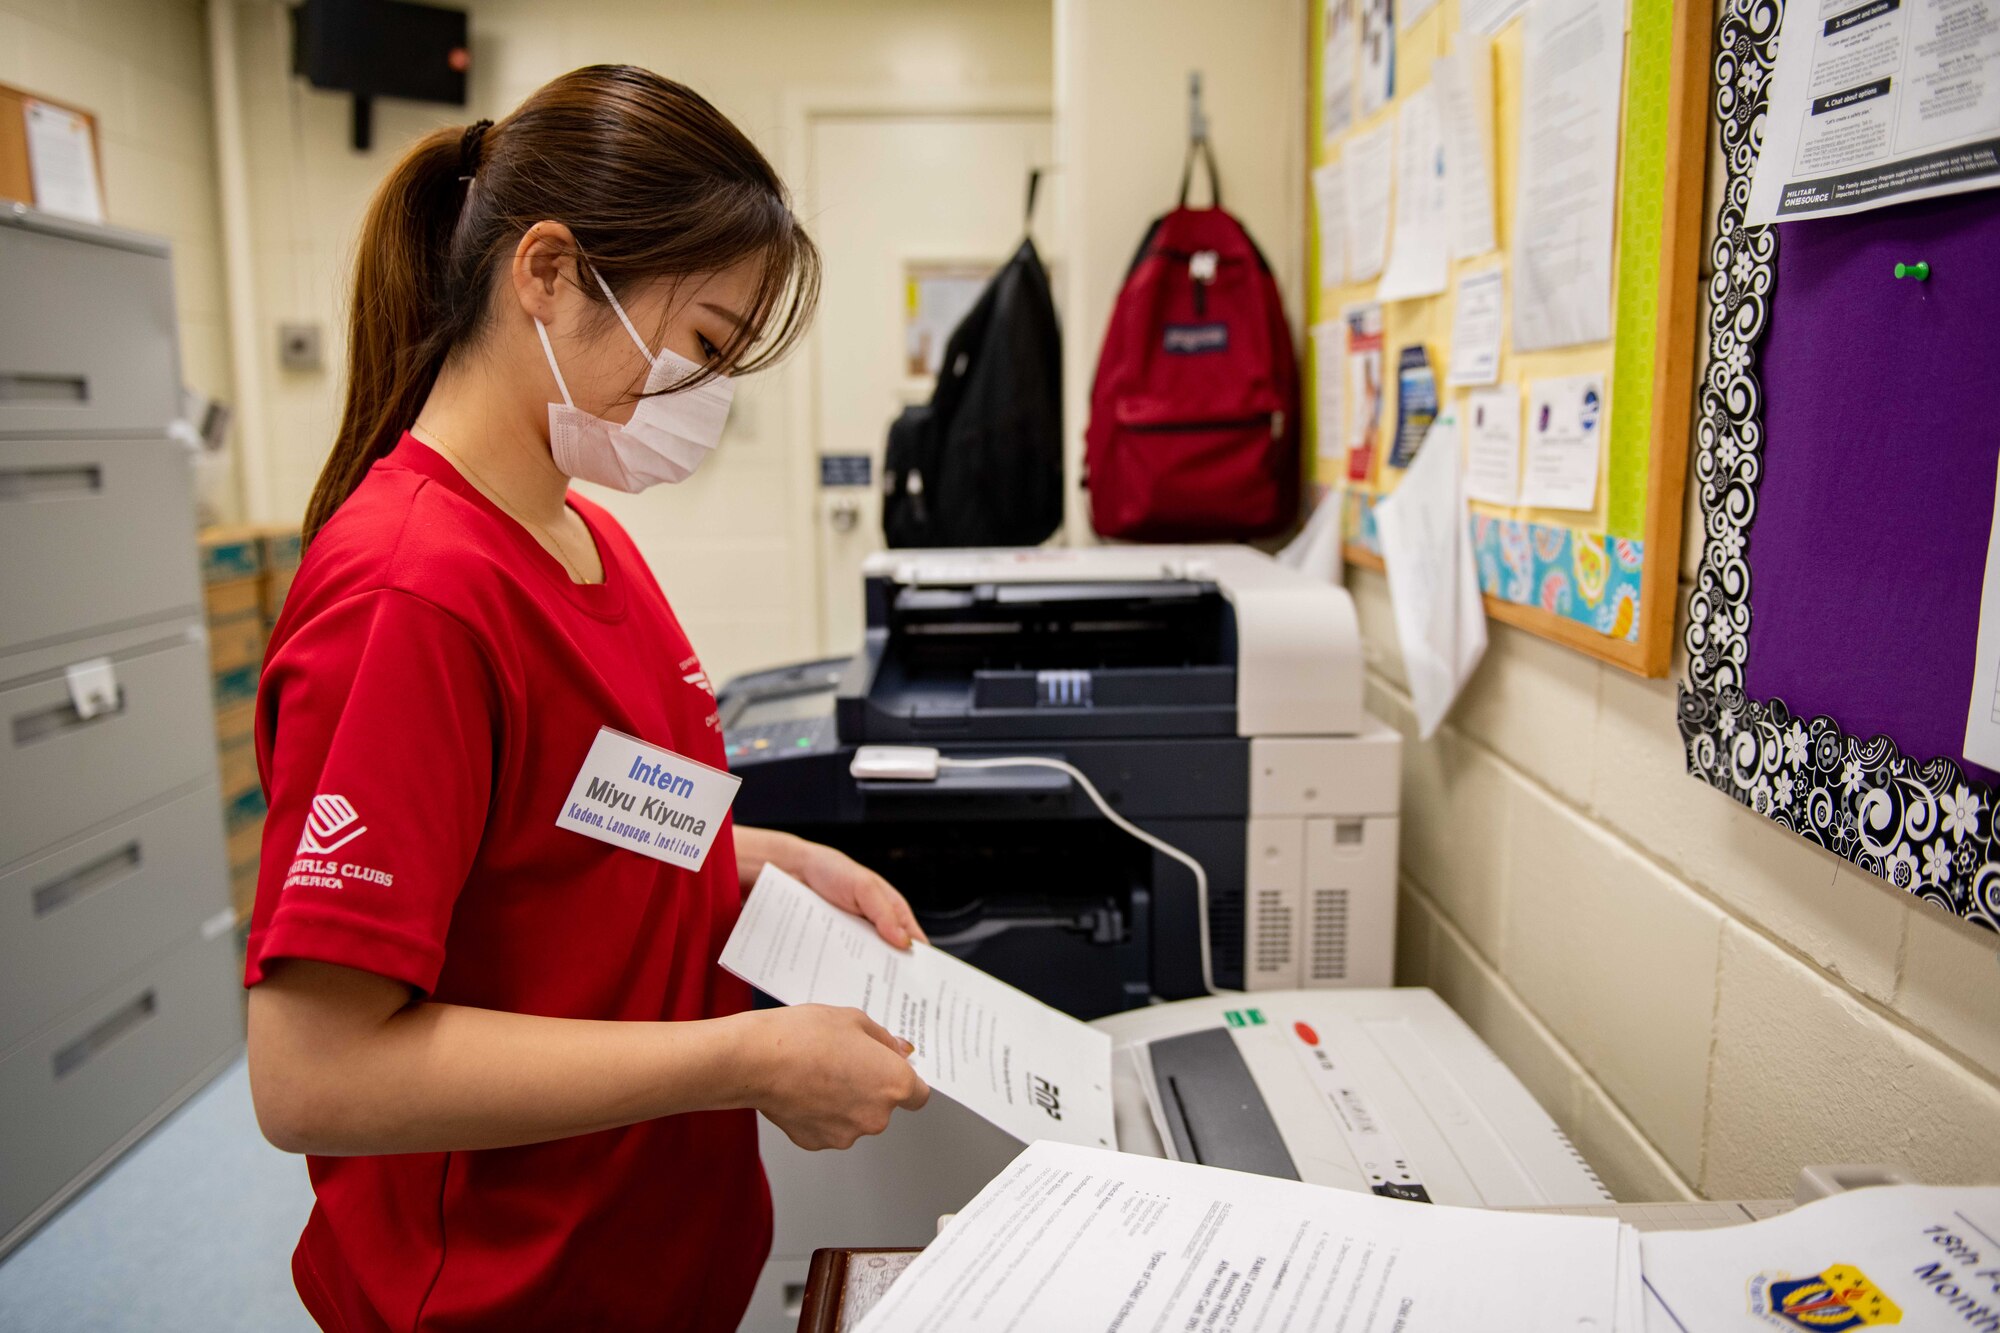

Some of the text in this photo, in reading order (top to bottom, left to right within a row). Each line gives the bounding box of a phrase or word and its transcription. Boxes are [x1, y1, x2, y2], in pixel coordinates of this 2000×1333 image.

[1842, 14, 1860, 26] Support
[1862, 10, 1870, 18] and
[1831, 98, 1842, 106] Chat
[1844, 93, 1857, 102] about
[1858, 87, 1877, 99] options
[1896, 169, 1913, 177] supports
[1787, 188, 1816, 198] MILITARY
[1836, 190, 1854, 198] impacted
[628, 755, 694, 799] Intern
[585, 776, 707, 836] Miyu Kiyuna
[654, 832, 700, 859] Institute
[340, 863, 394, 887] CLUBS
[1923, 1225, 1980, 1266] 18th
[1147, 1252, 1166, 1270] Types
[1139, 1271, 1155, 1279] of
[1130, 1281, 1148, 1298] Child
[1226, 1258, 1266, 1326] FAMILY ADVOCACY
